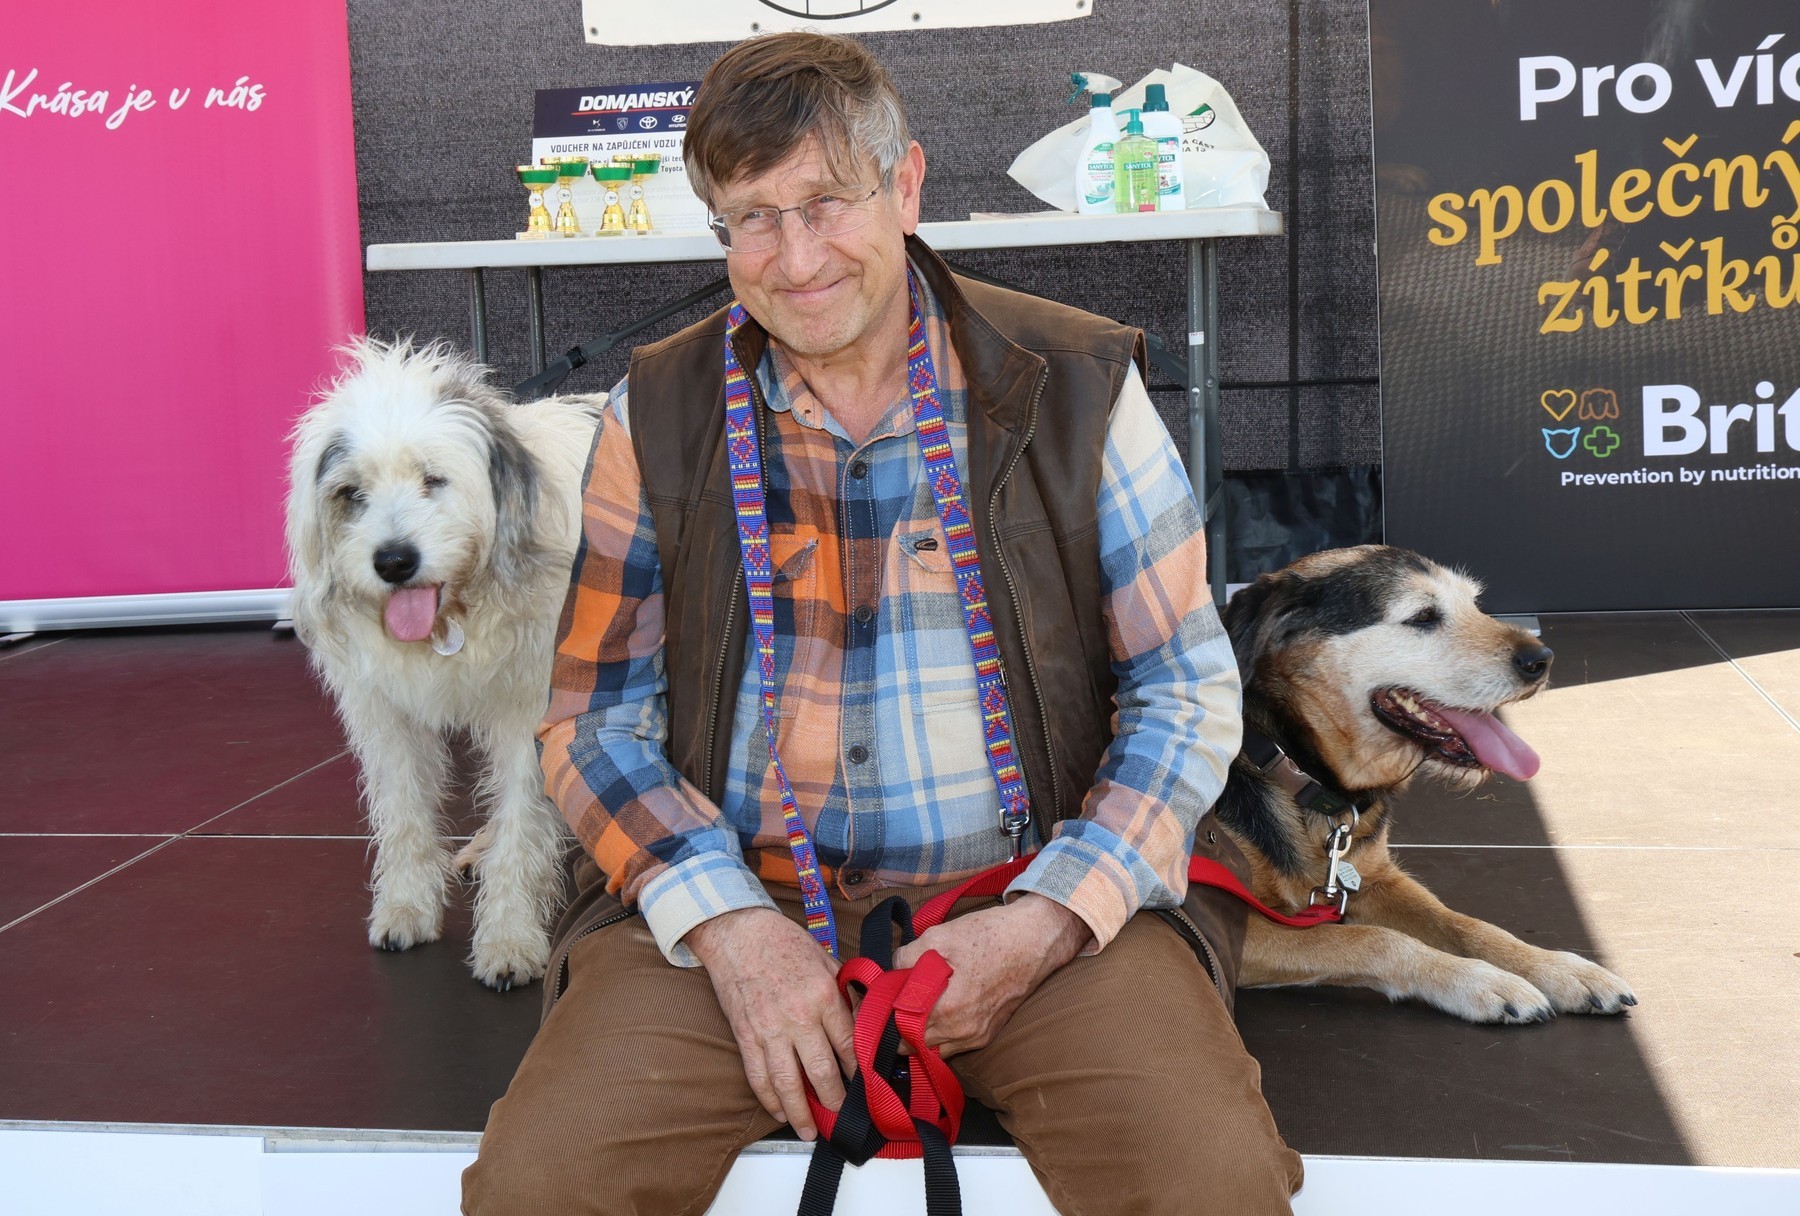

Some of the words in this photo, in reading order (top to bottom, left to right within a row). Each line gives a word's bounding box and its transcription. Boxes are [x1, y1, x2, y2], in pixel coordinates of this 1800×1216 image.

[0, 68, 109, 118] Krása
[105, 84, 157, 130] je
[169, 87, 191, 110] v
[204, 75, 267, 112] nás
[1519, 55, 1673, 121] Pro
[551, 143, 589, 153] VOUCHER
[592, 142, 604, 151] NA
[606, 138, 651, 151] ZAPŮJČENÍ
[654, 139, 676, 149] VOZU
[1125, 162, 1153, 170] SANYTOL
[661, 165, 683, 173] Toyota
[1538, 224, 1800, 335] zítřků
[1642, 380, 1800, 457] Brit
[1561, 467, 1674, 486] Prevention
[1680, 467, 1706, 486] by
[1711, 463, 1800, 482] nutrition
